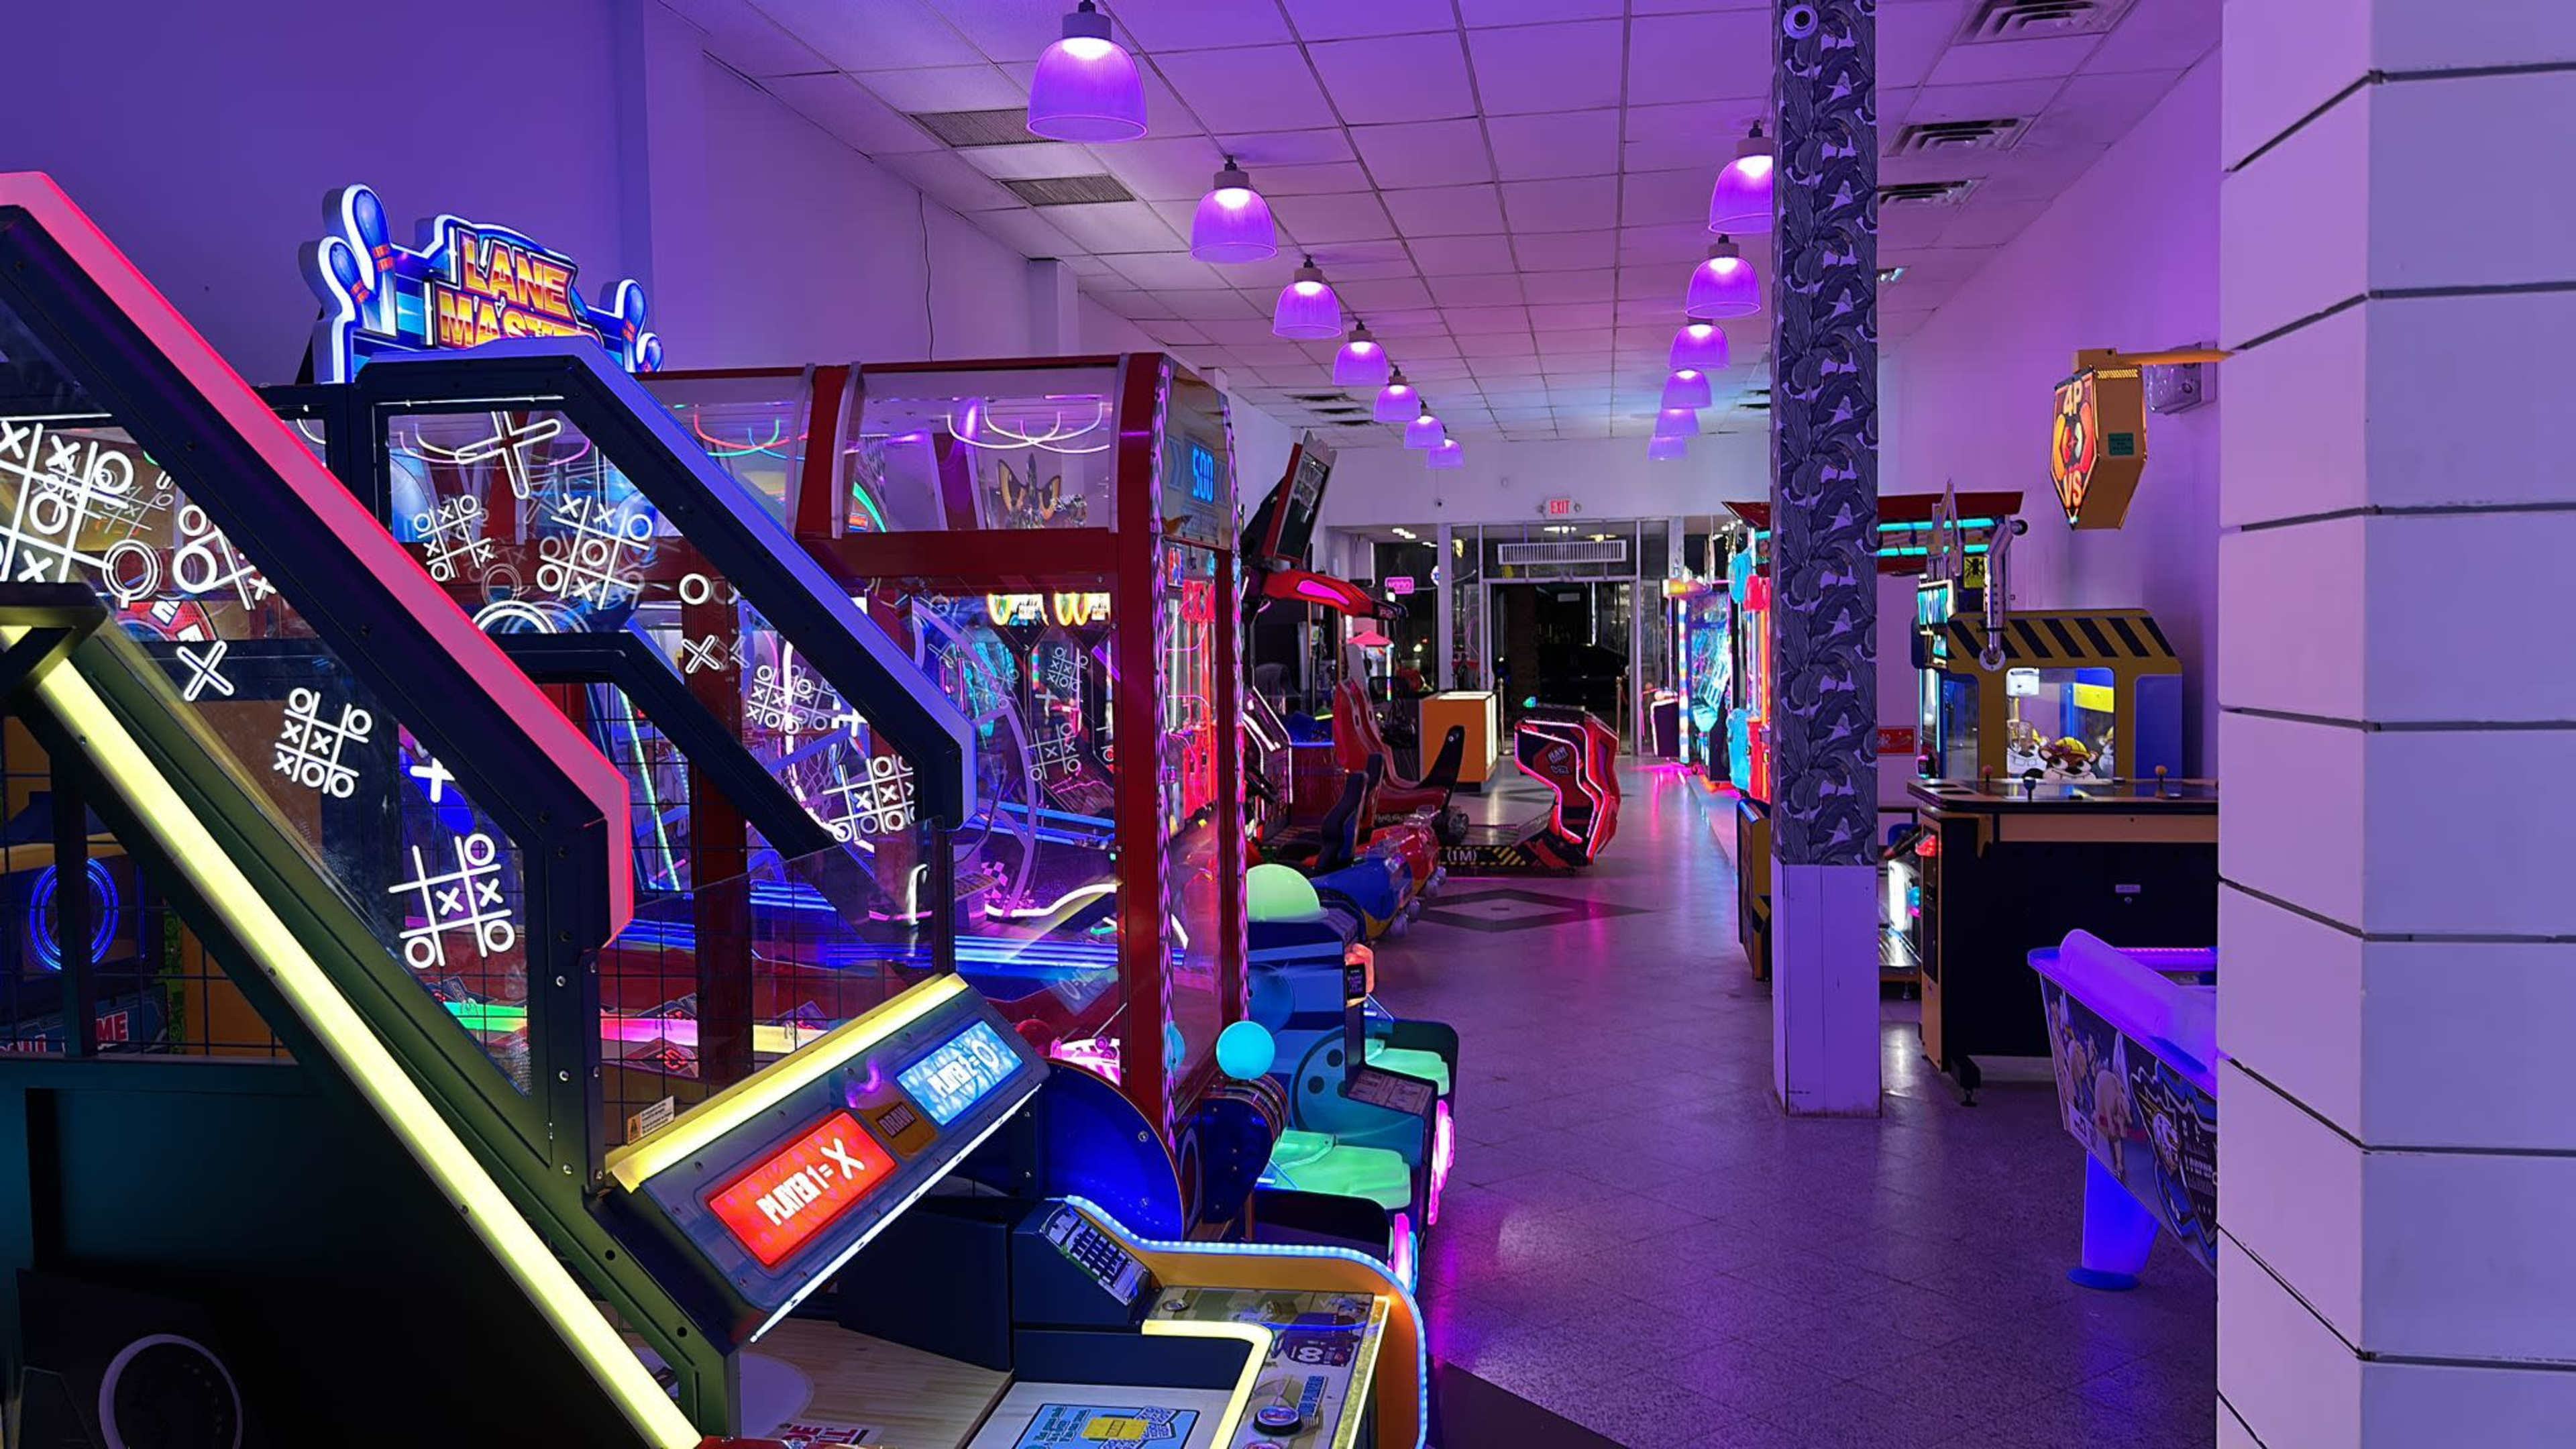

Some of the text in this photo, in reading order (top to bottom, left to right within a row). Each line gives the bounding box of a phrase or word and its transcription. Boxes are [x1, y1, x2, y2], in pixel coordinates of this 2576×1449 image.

[462, 234, 572, 319] LANE
[437, 288, 582, 347] MAS
[2063, 380, 2083, 416] 4P
[1548, 499, 1570, 515] EXIT
[2063, 470, 2083, 508] VS
[877, 1103, 916, 1138] DRAW
[755, 1171, 822, 1227] PLAYER
